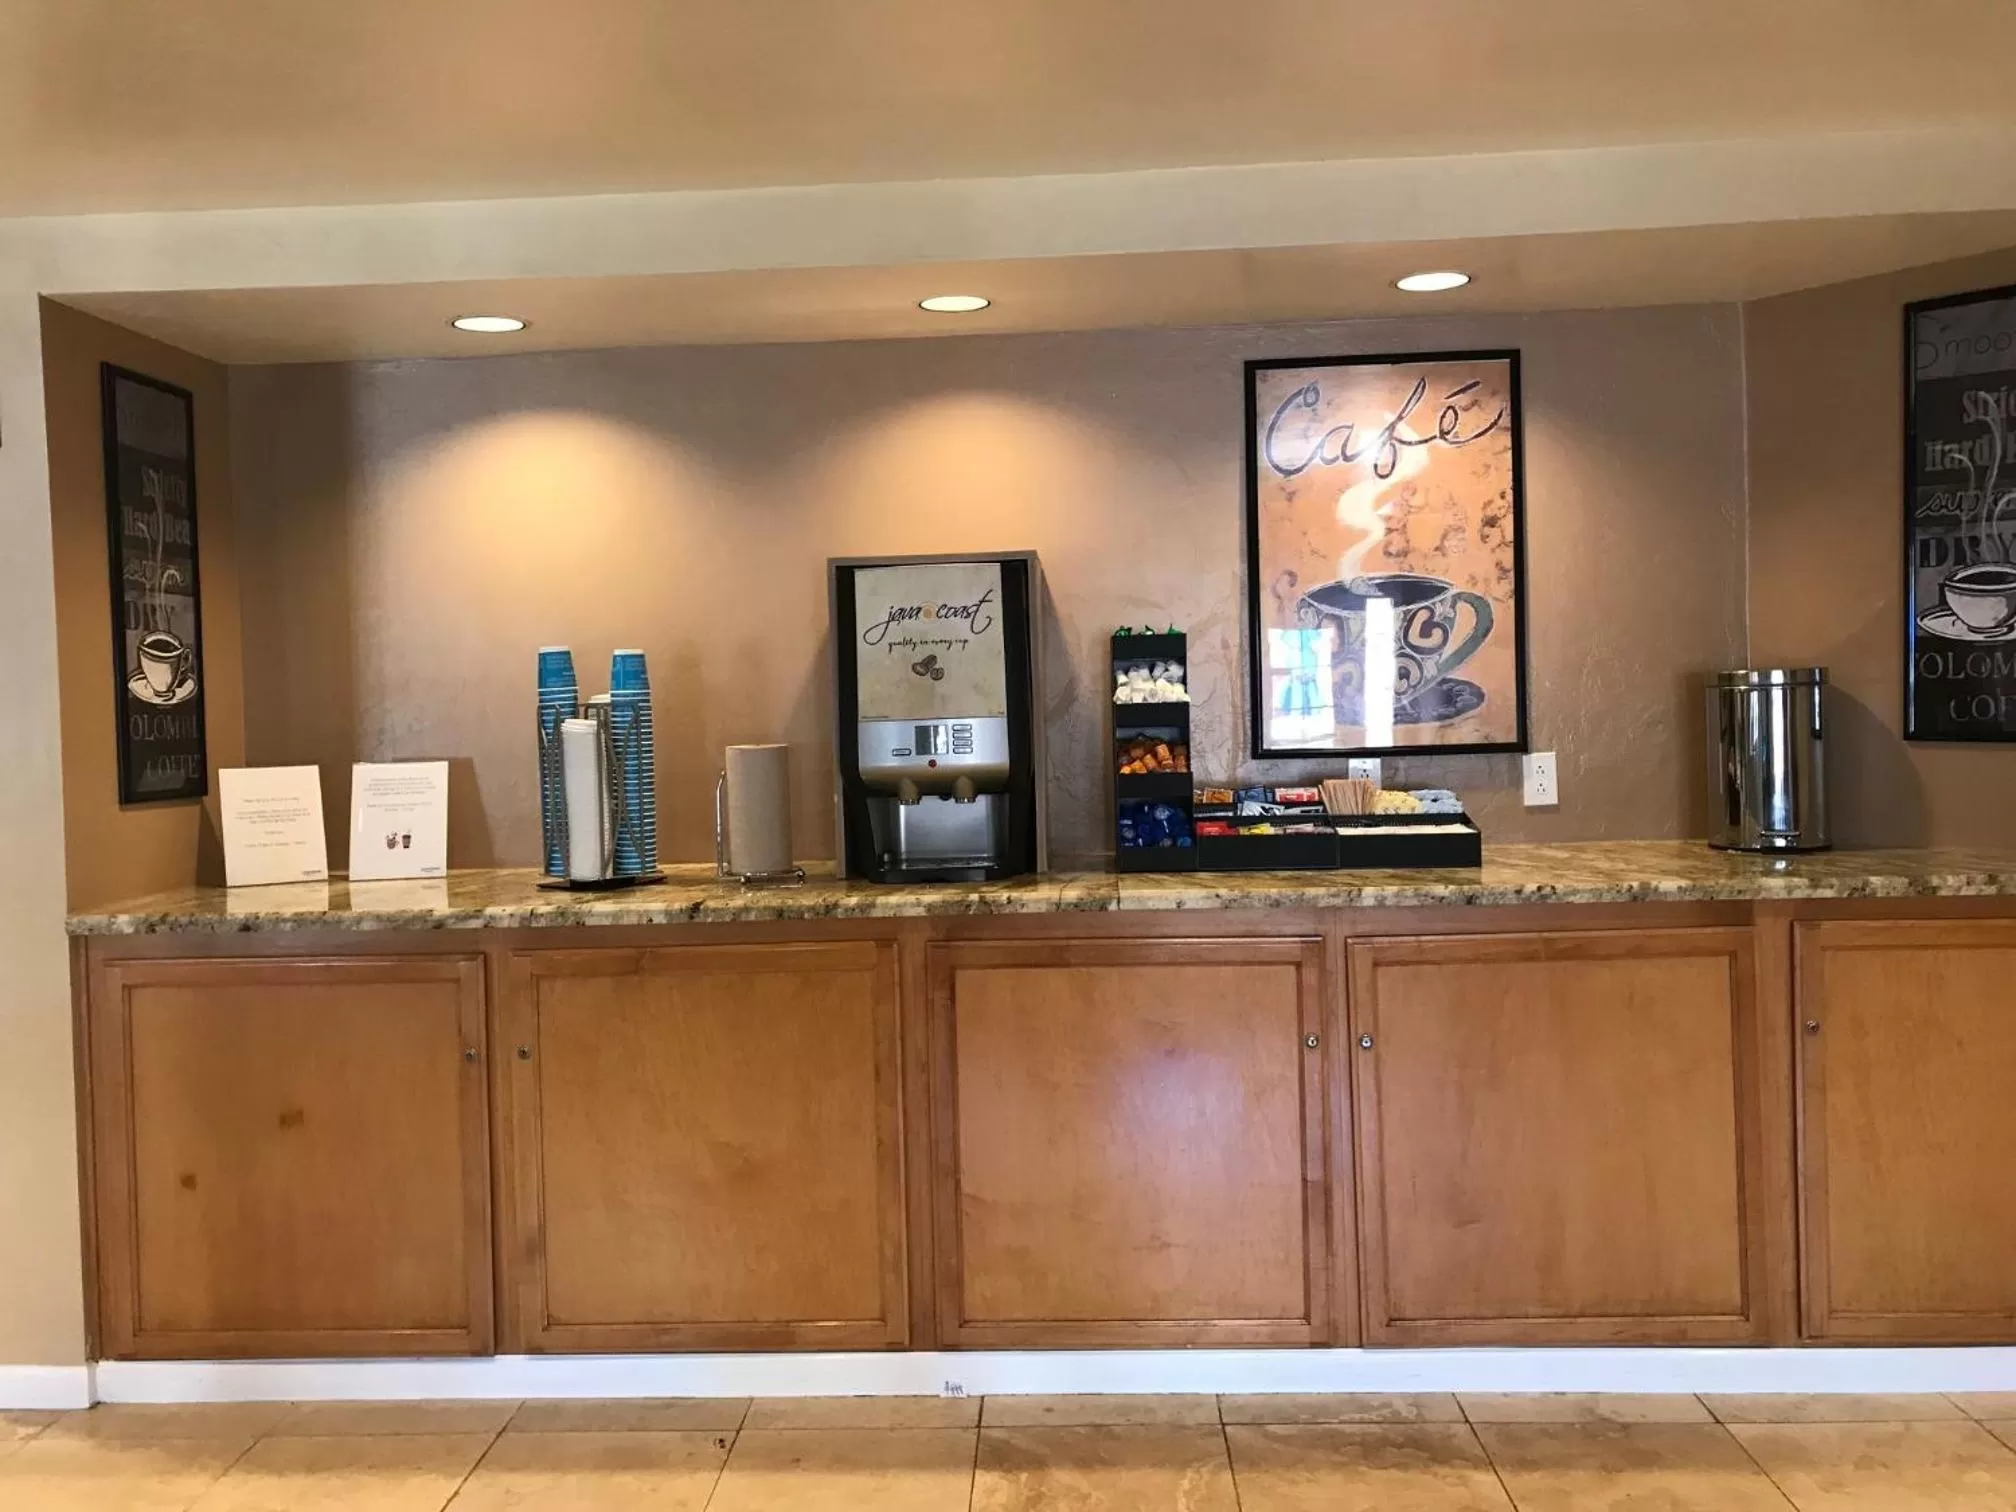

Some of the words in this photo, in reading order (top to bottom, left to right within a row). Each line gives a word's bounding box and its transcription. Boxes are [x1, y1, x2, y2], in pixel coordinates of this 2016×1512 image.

[1264, 375, 1505, 479] Café
[1924, 434, 1995, 472] Hard
[863, 605, 922, 646] java
[936, 588, 994, 635] coast
